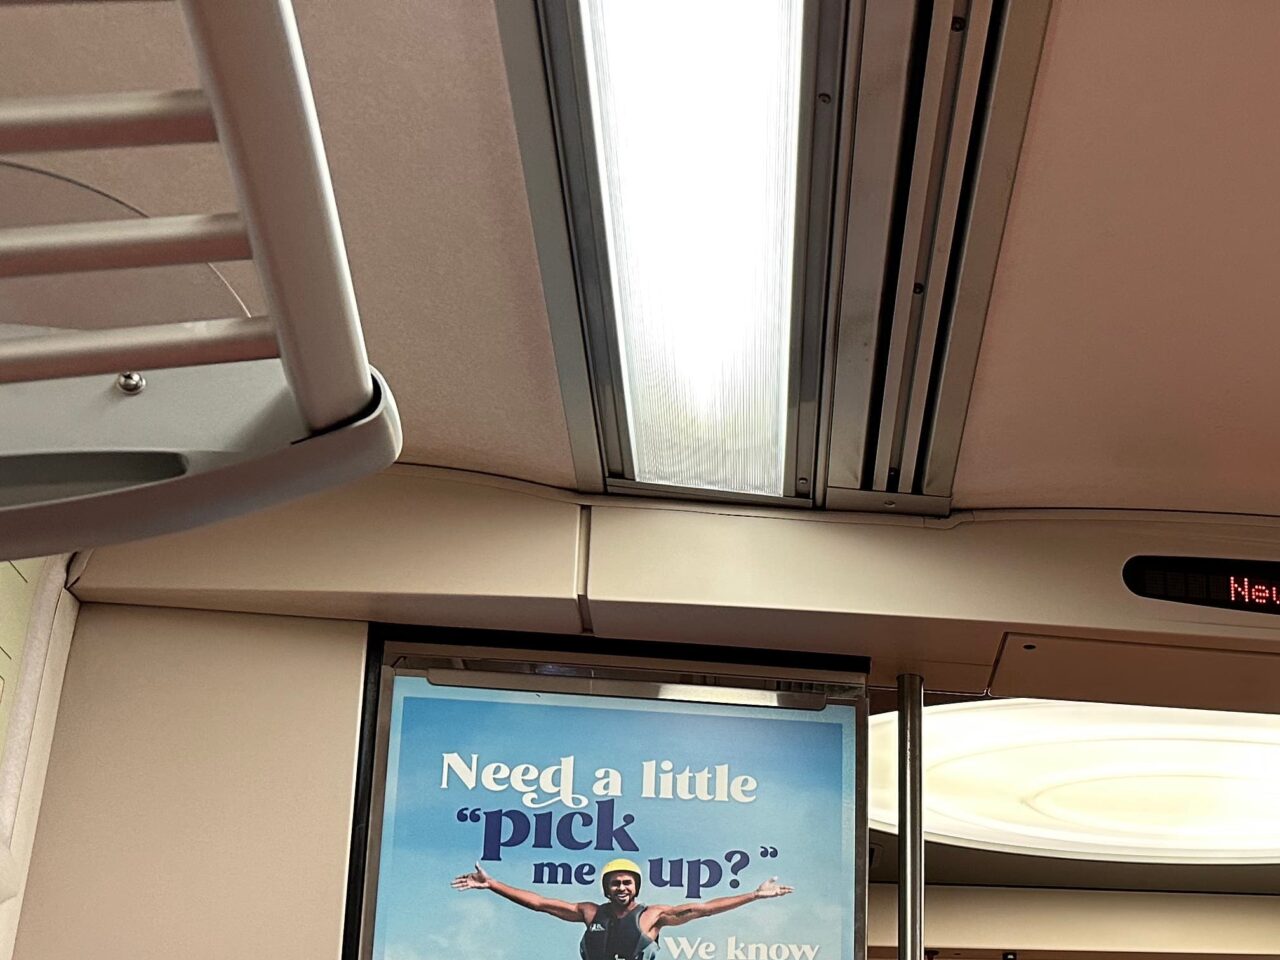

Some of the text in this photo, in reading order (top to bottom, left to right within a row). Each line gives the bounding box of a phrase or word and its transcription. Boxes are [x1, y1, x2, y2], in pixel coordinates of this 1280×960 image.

[440, 752, 758, 808] Need a little
[456, 799, 640, 862] “pick
[532, 861, 596, 886] me
[663, 936, 715, 960] We
